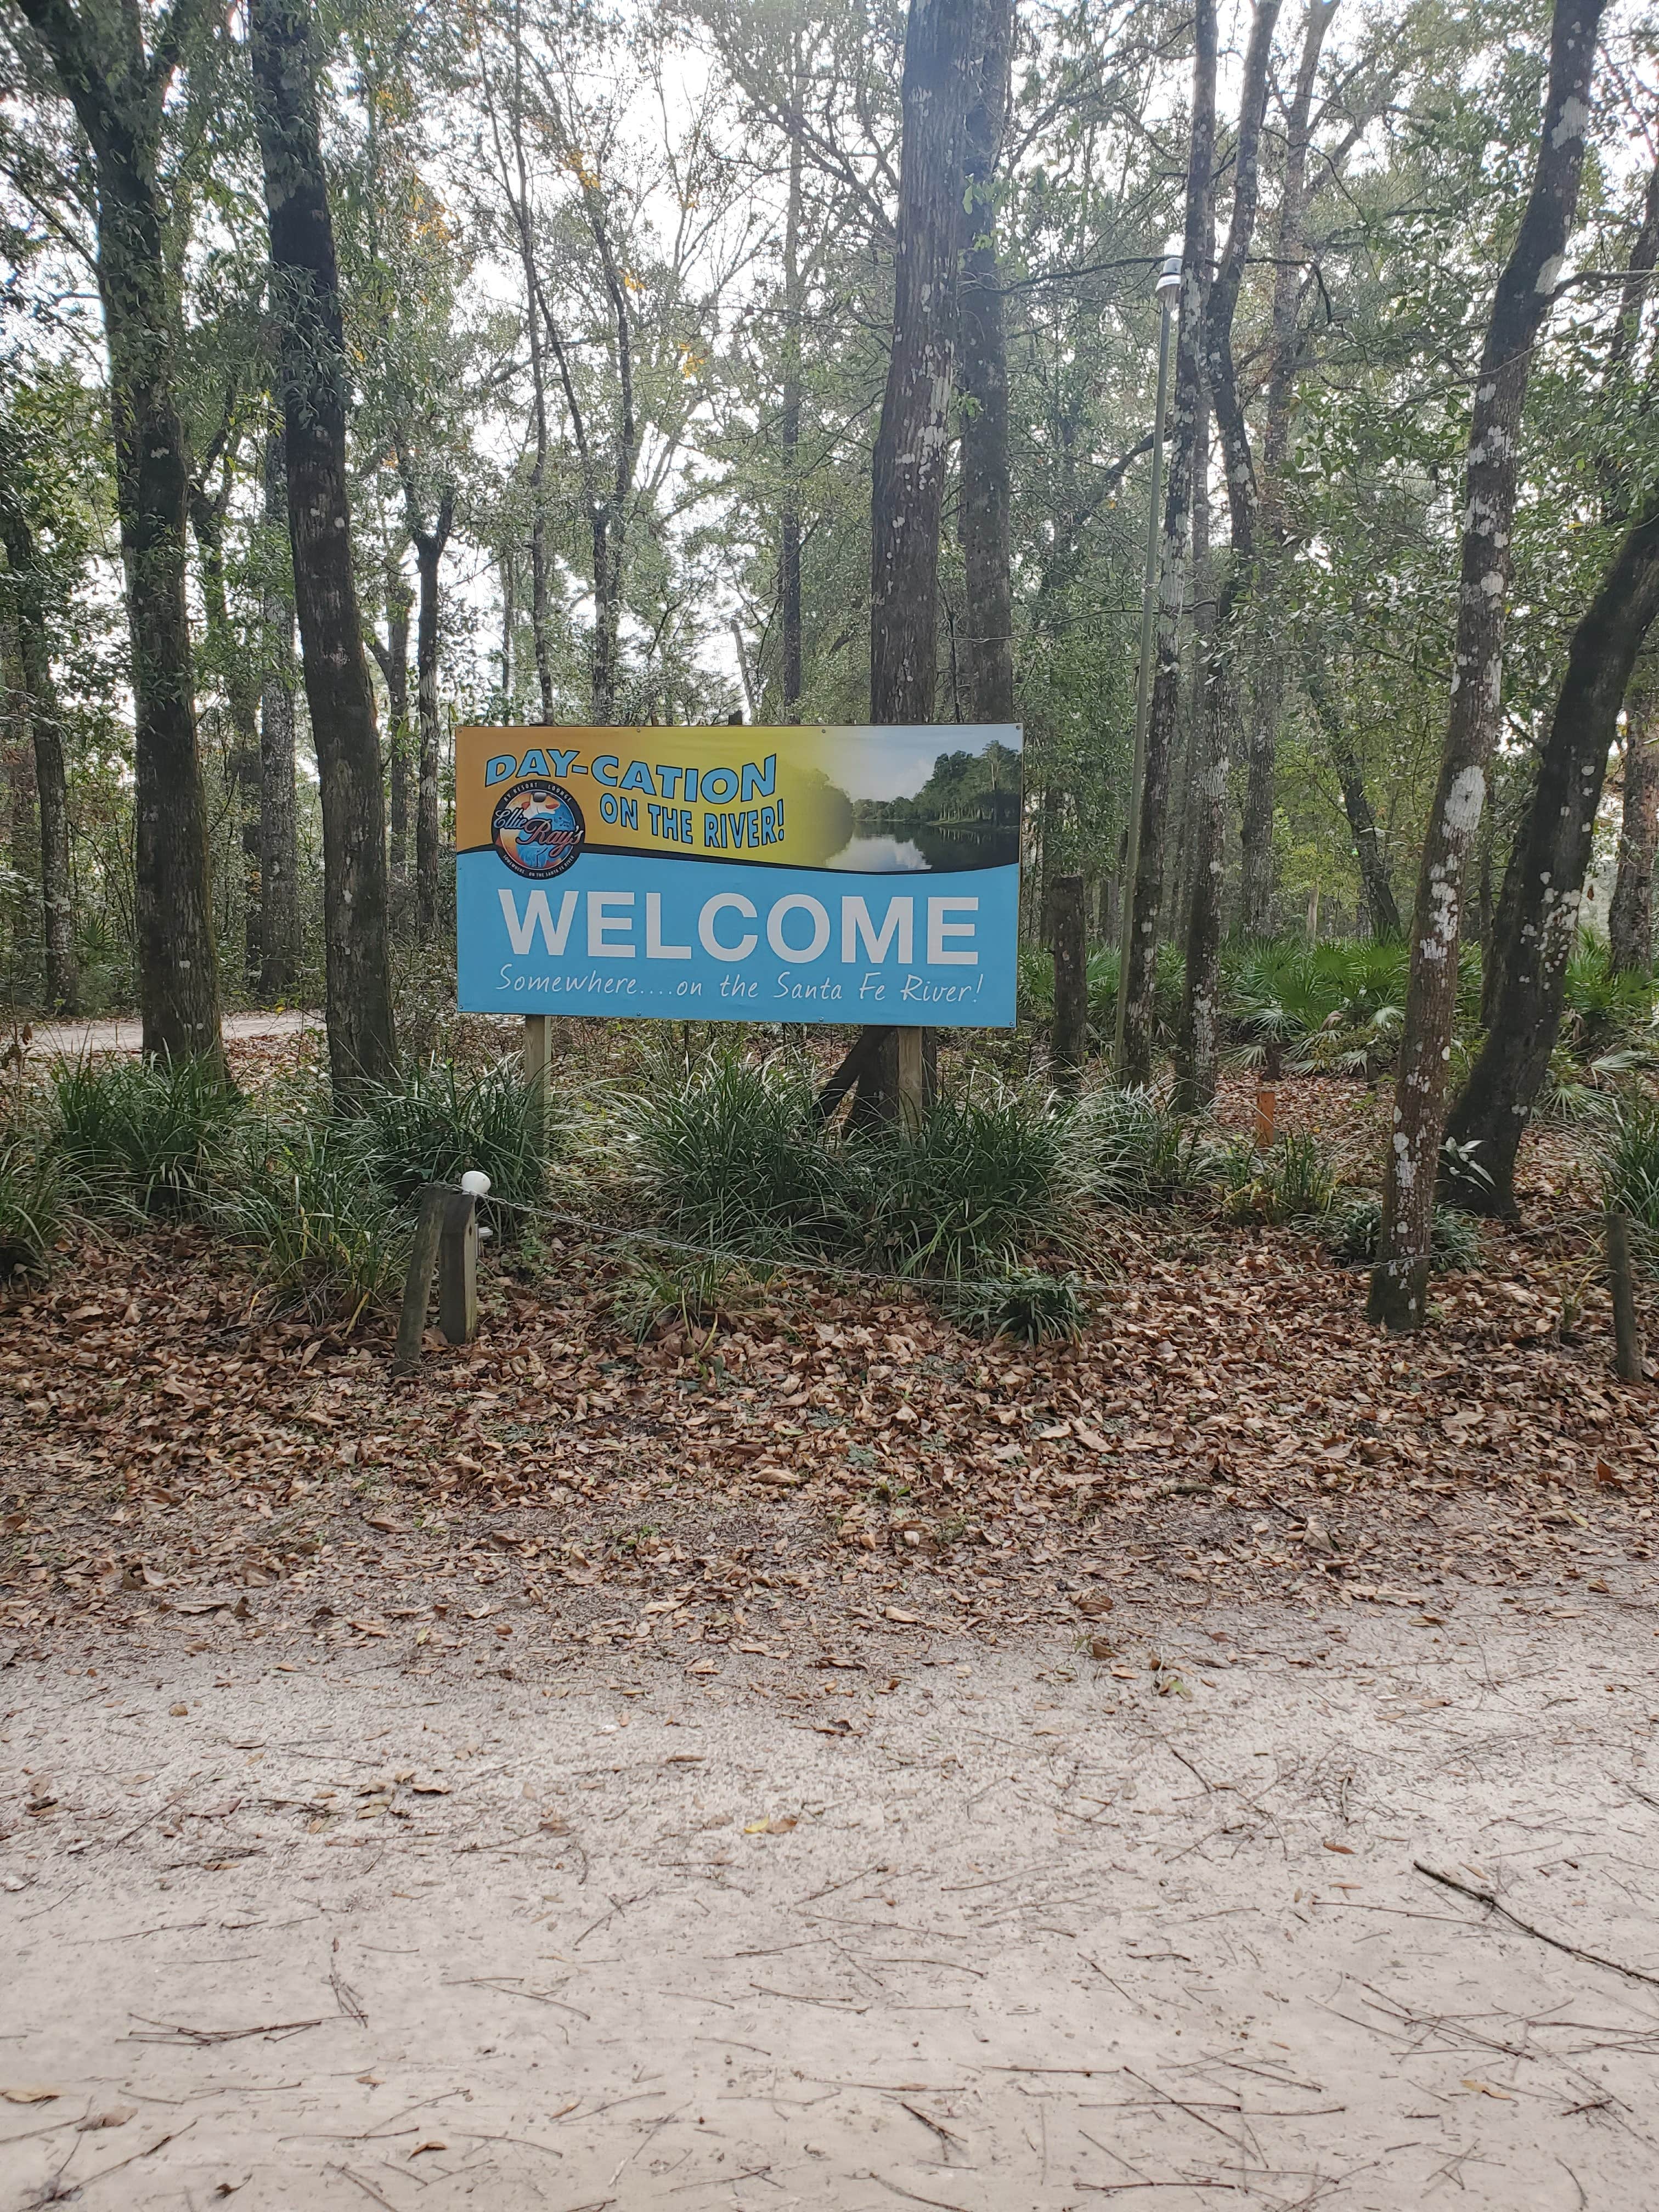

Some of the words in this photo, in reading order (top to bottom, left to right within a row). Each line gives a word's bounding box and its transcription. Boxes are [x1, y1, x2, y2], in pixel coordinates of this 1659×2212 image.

[485, 749, 777, 805] DAY-CATION
[504, 793, 511, 802] RV
[513, 782, 538, 794] RESORT
[548, 785, 572, 802] LOUNGE
[494, 808, 528, 829] Ellie
[516, 818, 584, 857] Ray's
[600, 792, 639, 831] ON
[647, 803, 693, 844] THE
[704, 799, 785, 849] RIVER!
[564, 855, 575, 867] RIVER
[498, 888, 979, 964] WELCOME
[720, 974, 759, 998] the
[772, 971, 843, 1000] Santa
[859, 972, 885, 1001] Fe
[900, 973, 984, 1003] River!
